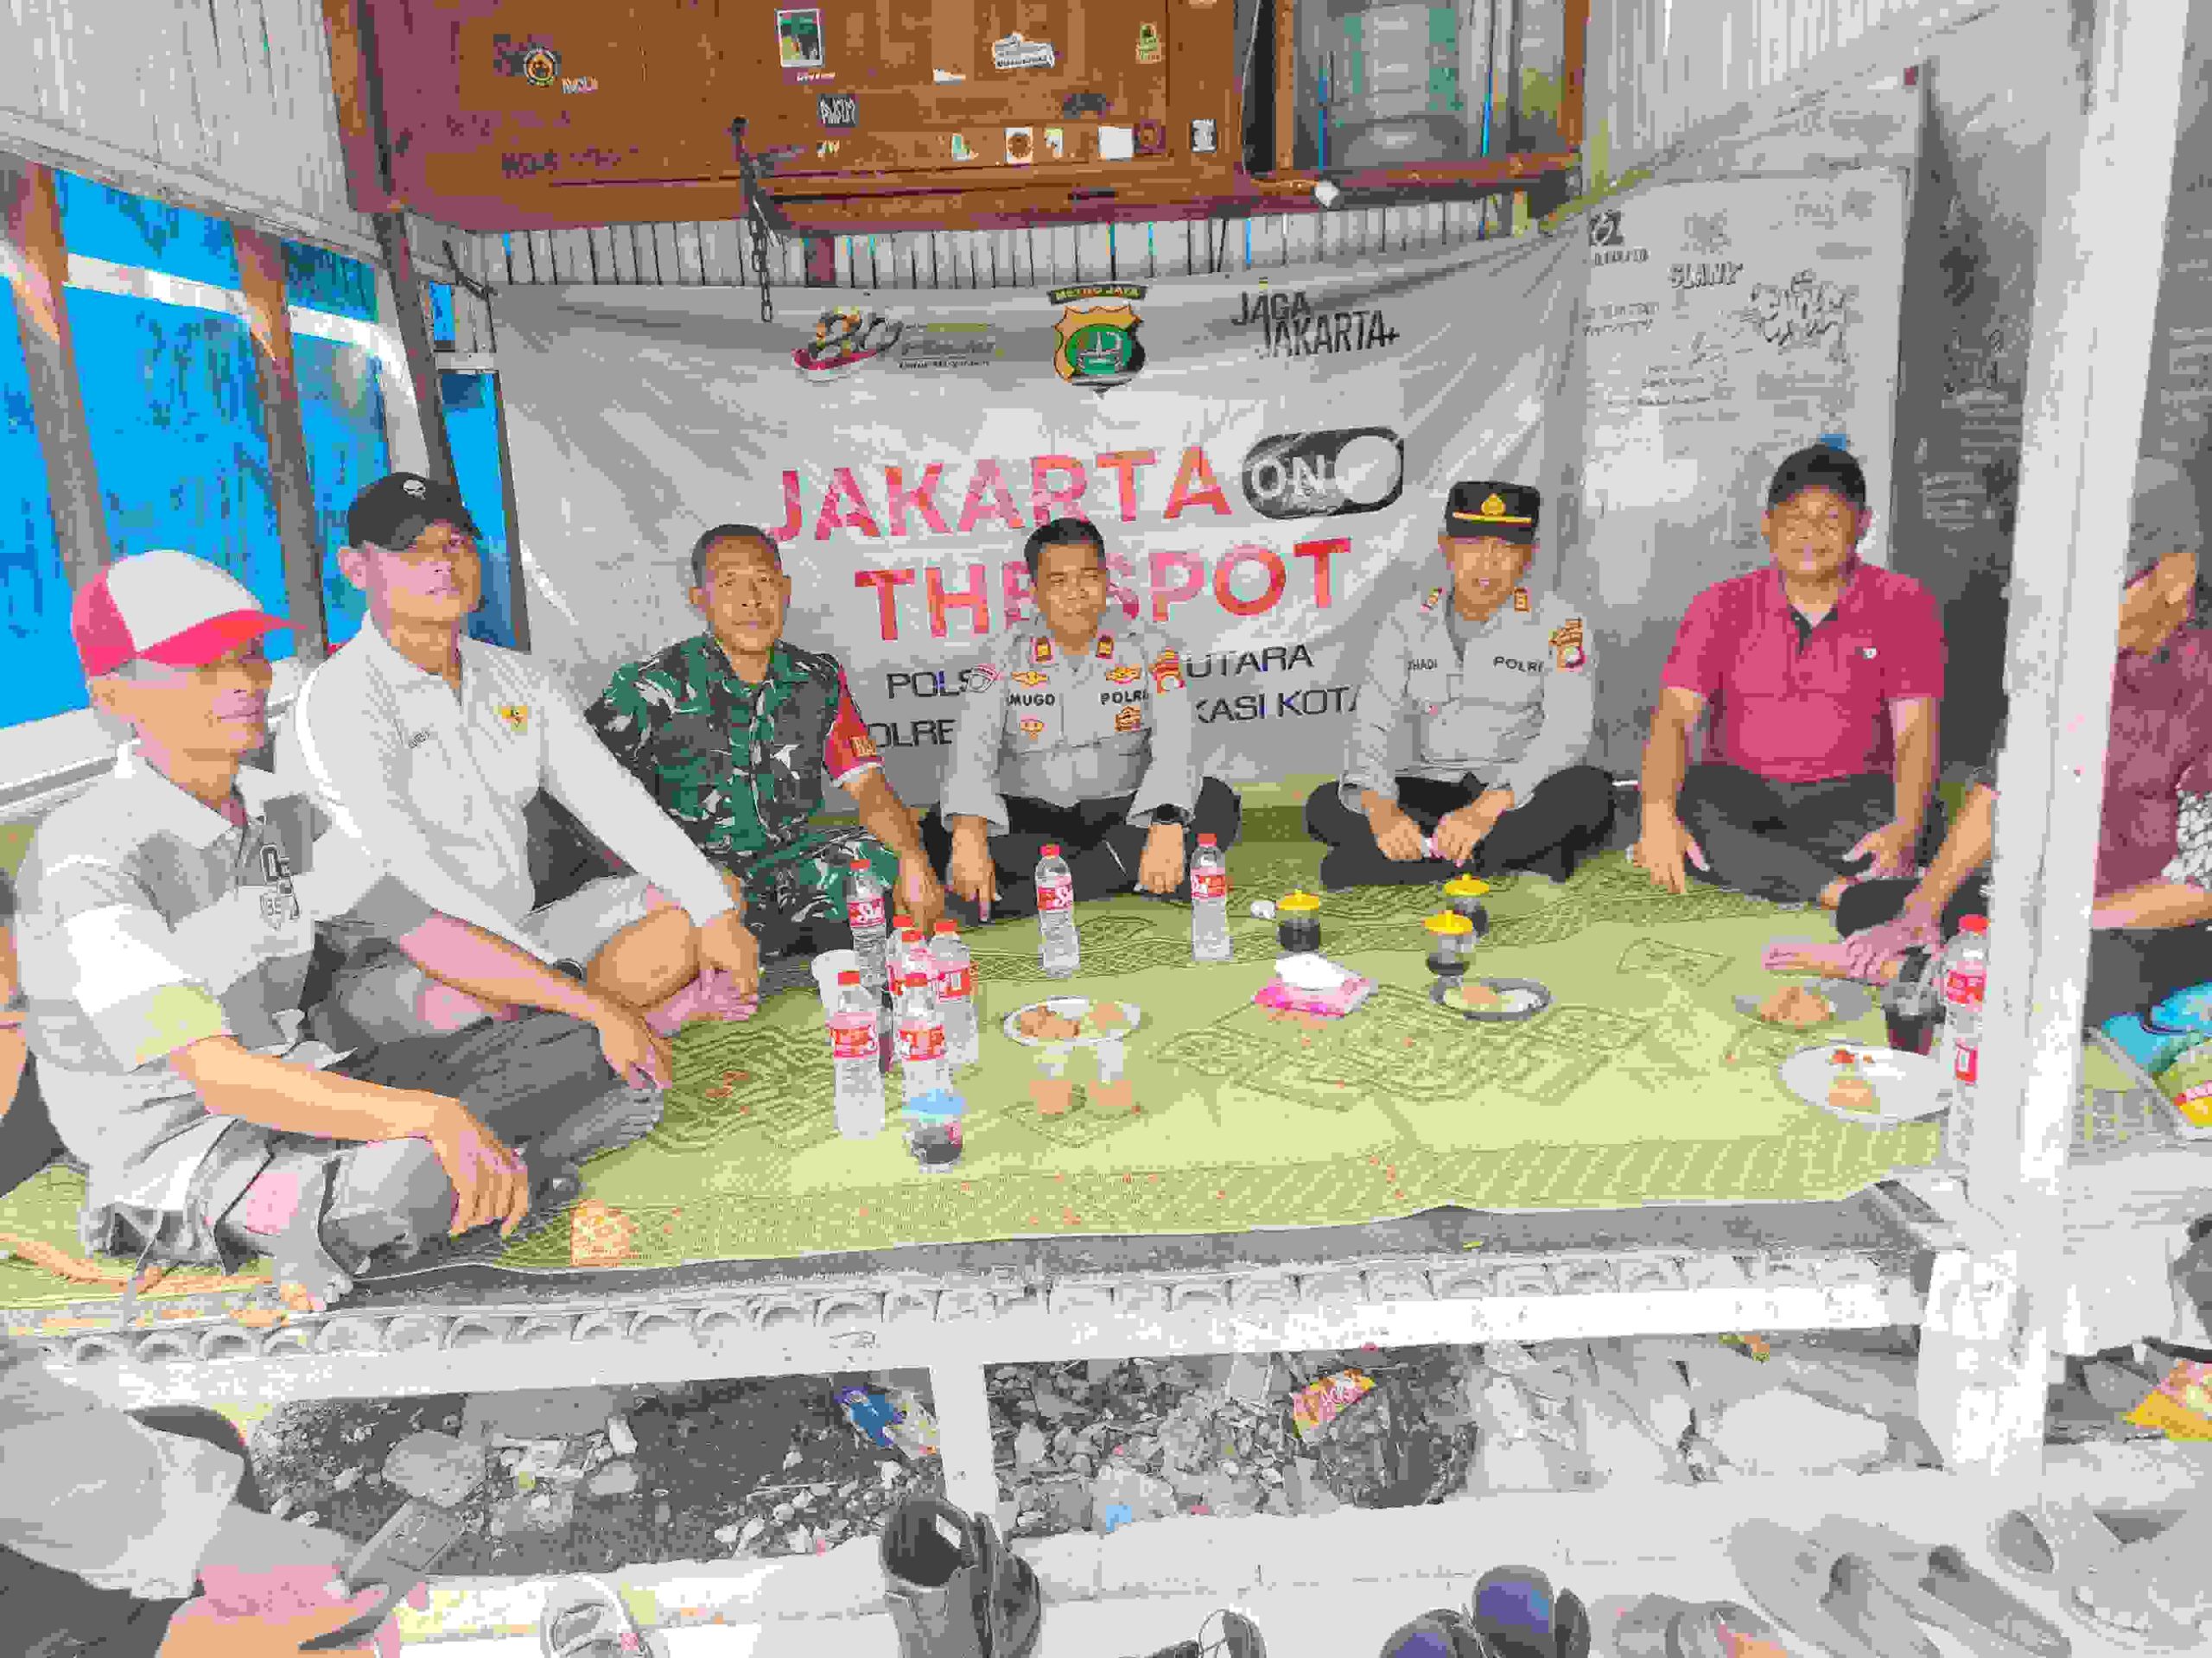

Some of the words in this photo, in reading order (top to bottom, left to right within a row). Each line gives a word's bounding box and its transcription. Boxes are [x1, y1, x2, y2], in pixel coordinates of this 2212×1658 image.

[1231, 290, 1312, 326] JAGA
[764, 446, 1232, 542] JAKARTA
[1250, 454, 1326, 499] ON
[1185, 644, 1314, 678] UTARA
[1493, 656, 1545, 673] POLRI
